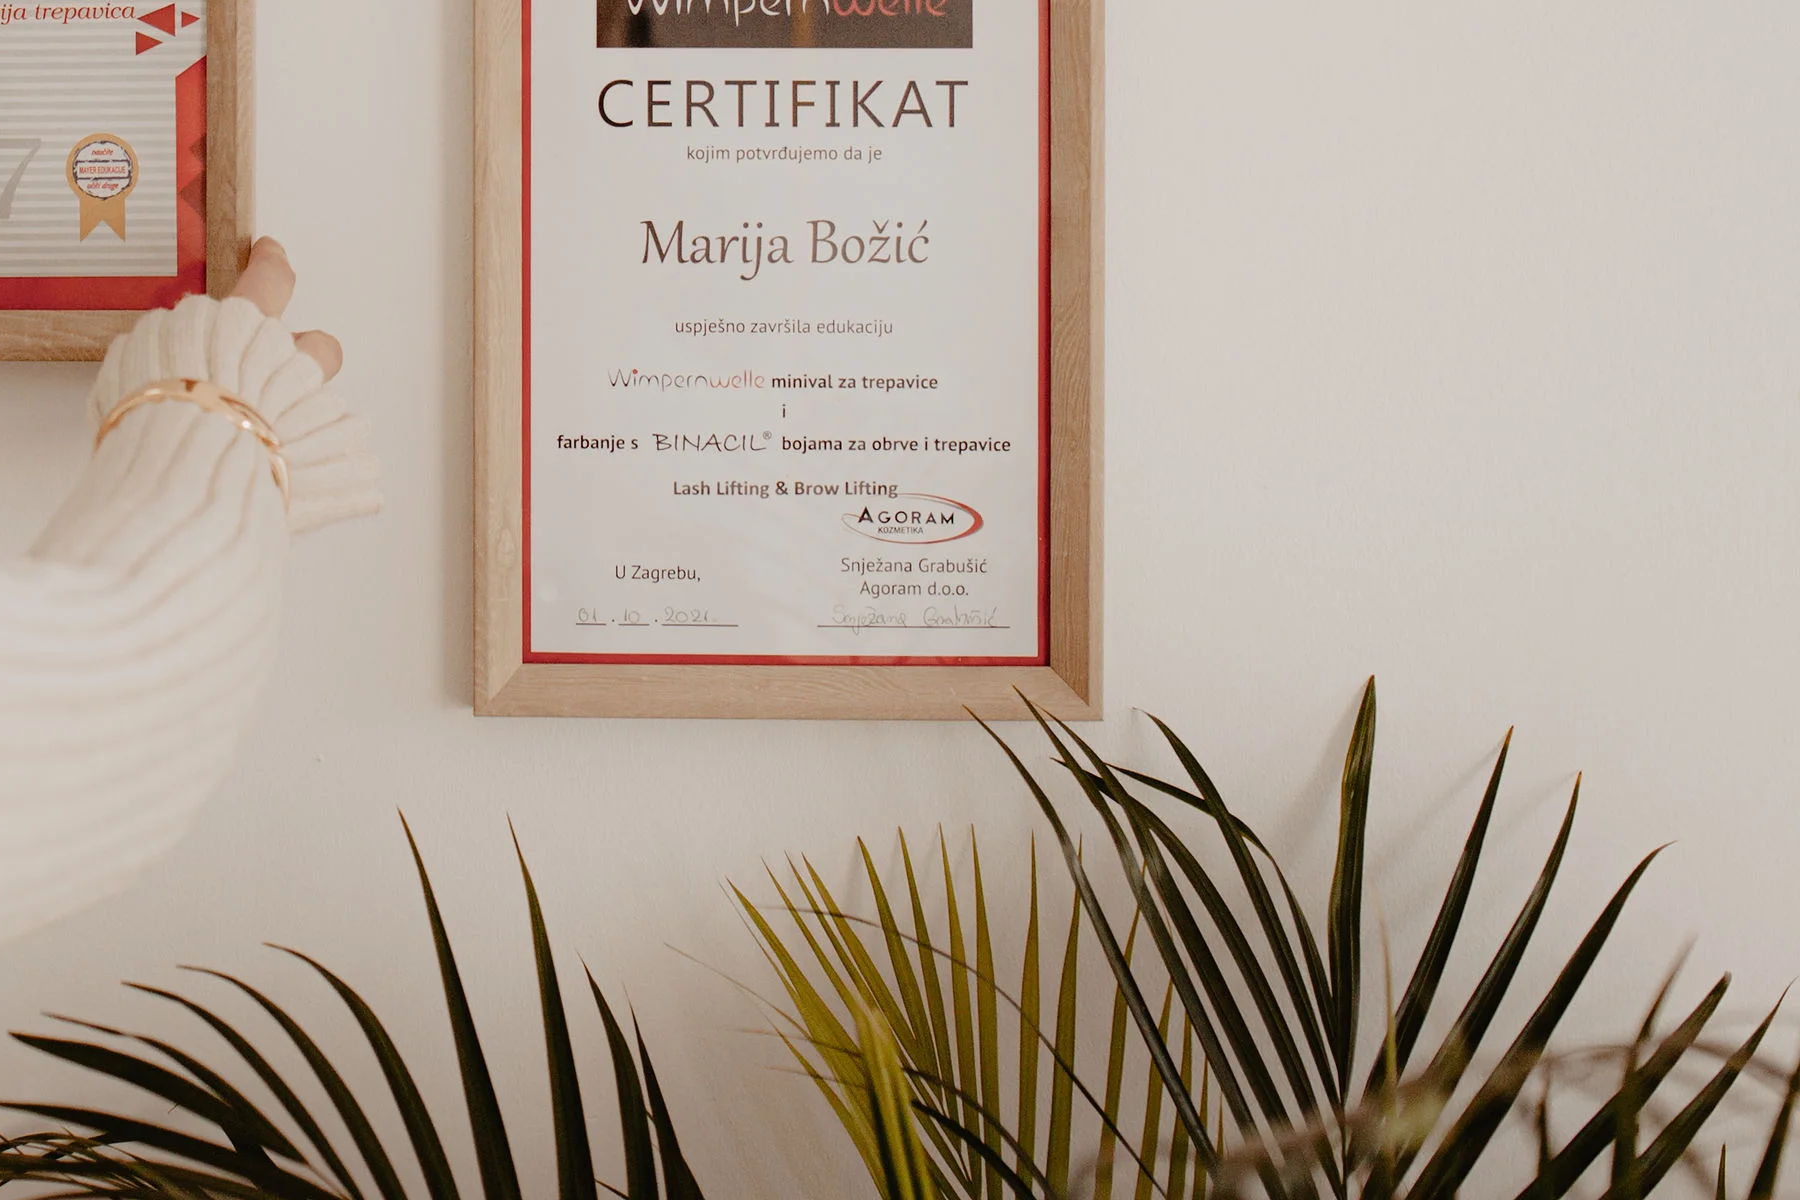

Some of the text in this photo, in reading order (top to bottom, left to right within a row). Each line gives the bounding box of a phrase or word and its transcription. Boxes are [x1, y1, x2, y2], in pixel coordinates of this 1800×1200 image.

[35, 3, 136, 25] trepavica
[598, 79, 969, 129] CERTIFIKAT
[687, 145, 883, 164] kojim potvrđujemo da je
[640, 219, 930, 281] Marija Božić
[675, 318, 893, 338] uspješno završila edukaciju
[607, 368, 938, 393] Wimpernwelle minival za trepavice
[782, 403, 786, 418] i
[557, 434, 625, 454] farbanje
[630, 439, 639, 451] s
[782, 436, 843, 454] bojama
[848, 439, 866, 452] za
[872, 436, 919, 452] obrve
[924, 436, 929, 452] i
[933, 437, 1011, 457] trepavice
[673, 481, 898, 499] Lash Lifting & Brow Lifting
[858, 506, 955, 524] AGORAM
[877, 526, 924, 535] KOZMETIKA
[615, 564, 701, 583] U Zagrebu,
[841, 557, 988, 575] Snježana Grabušić
[860, 581, 969, 598] Agoram d.o.o.
